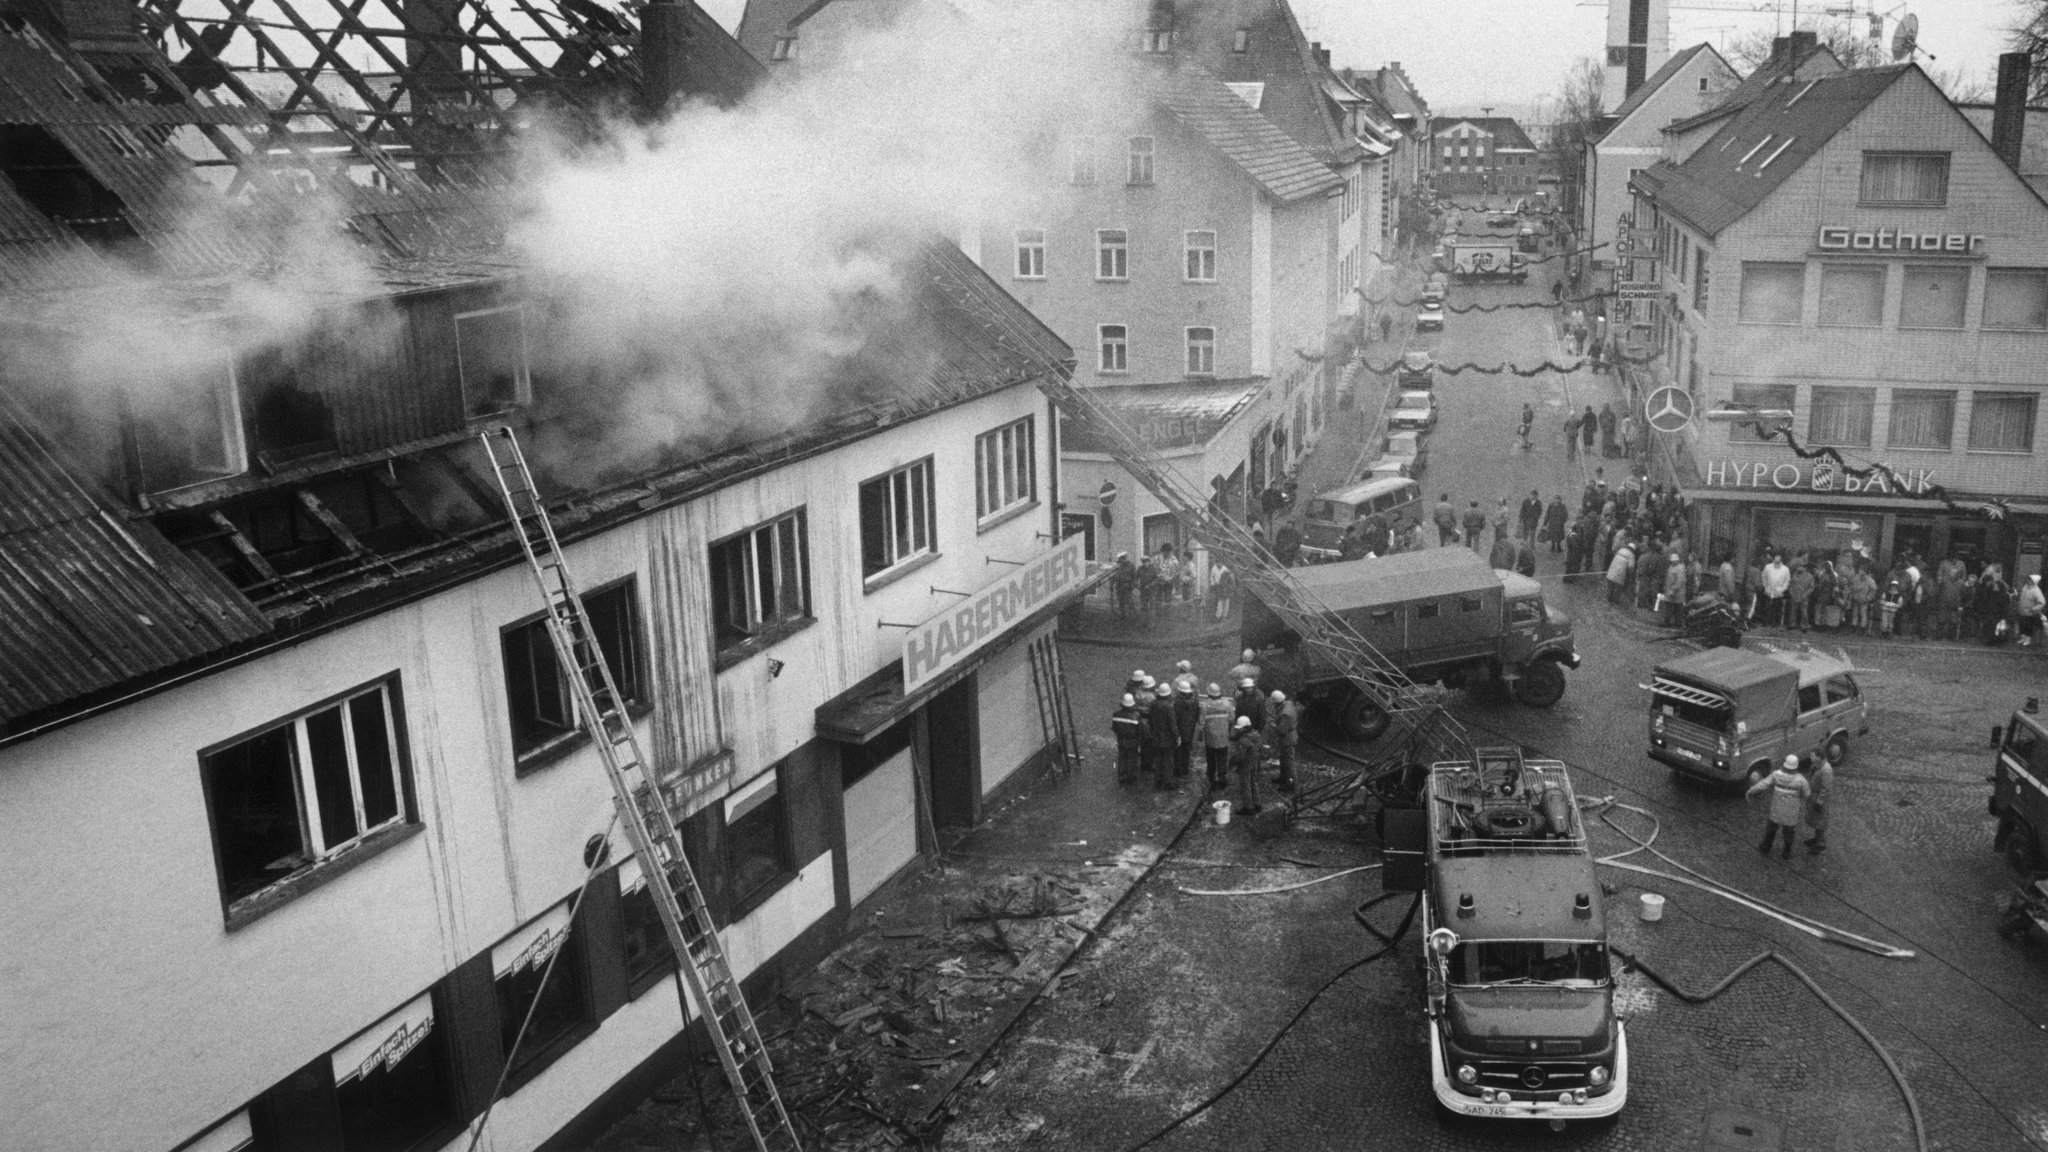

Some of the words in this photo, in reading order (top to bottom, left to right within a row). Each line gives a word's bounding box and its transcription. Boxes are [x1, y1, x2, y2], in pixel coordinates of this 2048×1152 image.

[1819, 226, 1985, 250] Gothaer
[1615, 213, 1628, 324] APOTHKE
[1707, 461, 1800, 489] HYPO
[908, 544, 1079, 684] HABERMEIER
[513, 934, 549, 972] Einfach
[361, 1029, 406, 1077] Einfach
[388, 1021, 430, 1064] Spitze!
